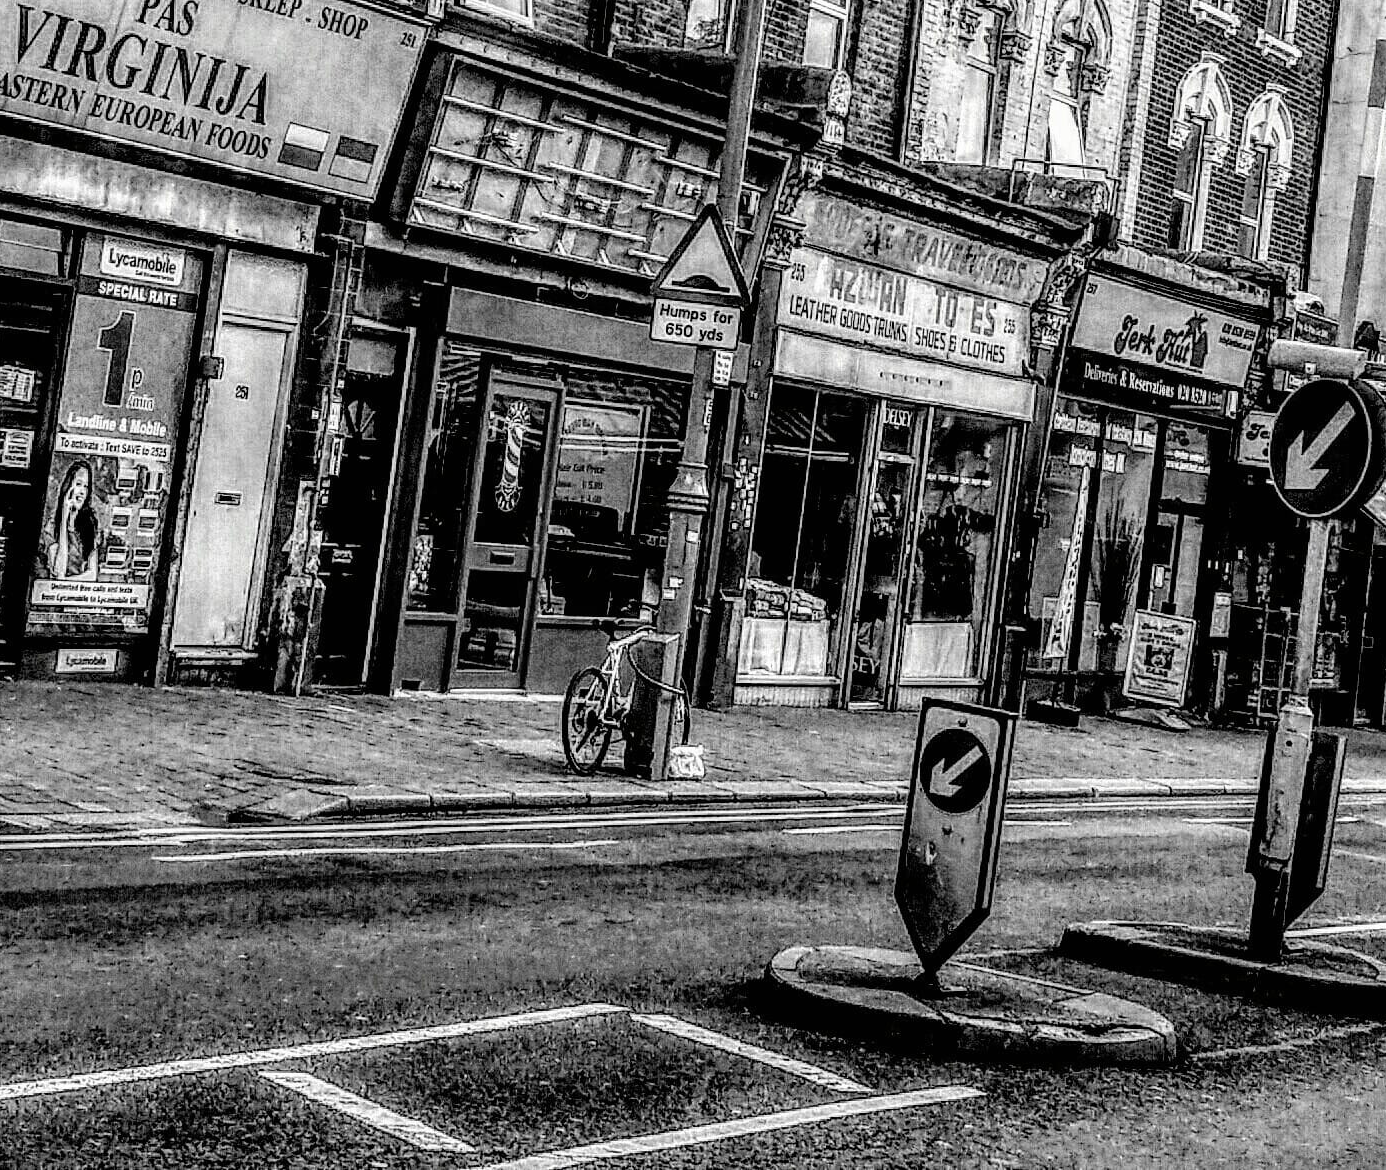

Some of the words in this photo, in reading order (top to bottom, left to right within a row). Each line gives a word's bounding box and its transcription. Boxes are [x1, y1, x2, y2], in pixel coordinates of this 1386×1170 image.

[317, 6, 369, 41] SHOP
[399, 31, 417, 49] 251
[15, 3, 269, 126] VIRGINIJA
[89, 93, 205, 143] EUROPEAN
[204, 123, 272, 160] FOODS
[108, 247, 177, 274] Lycamobile
[97, 280, 147, 302] SPECIAL
[147, 289, 178, 307] RATE
[659, 303, 707, 322] Humps
[713, 310, 734, 324] for
[665, 322, 693, 338] 650
[698, 328, 724, 341] yds
[789, 294, 838, 326] LEATHER
[839, 307, 872, 334] GOODS
[873, 315, 908, 343] TRUNKS
[915, 326, 947, 351] SHOES
[960, 338, 1006, 364] CLOTHES
[1114, 314, 1156, 355] Jerk
[97, 310, 136, 407] 1
[129, 366, 145, 392] p
[1083, 361, 1118, 386] Deliveries
[1119, 370, 1128, 388] &
[1128, 371, 1175, 398] Reservations
[67, 411, 117, 432] Landline
[118, 417, 127, 433] &
[129, 419, 167, 438] Mobile
[884, 407, 912, 427] DELSEY
[105, 441, 121, 454] Text
[121, 443, 141, 455] SAVE
